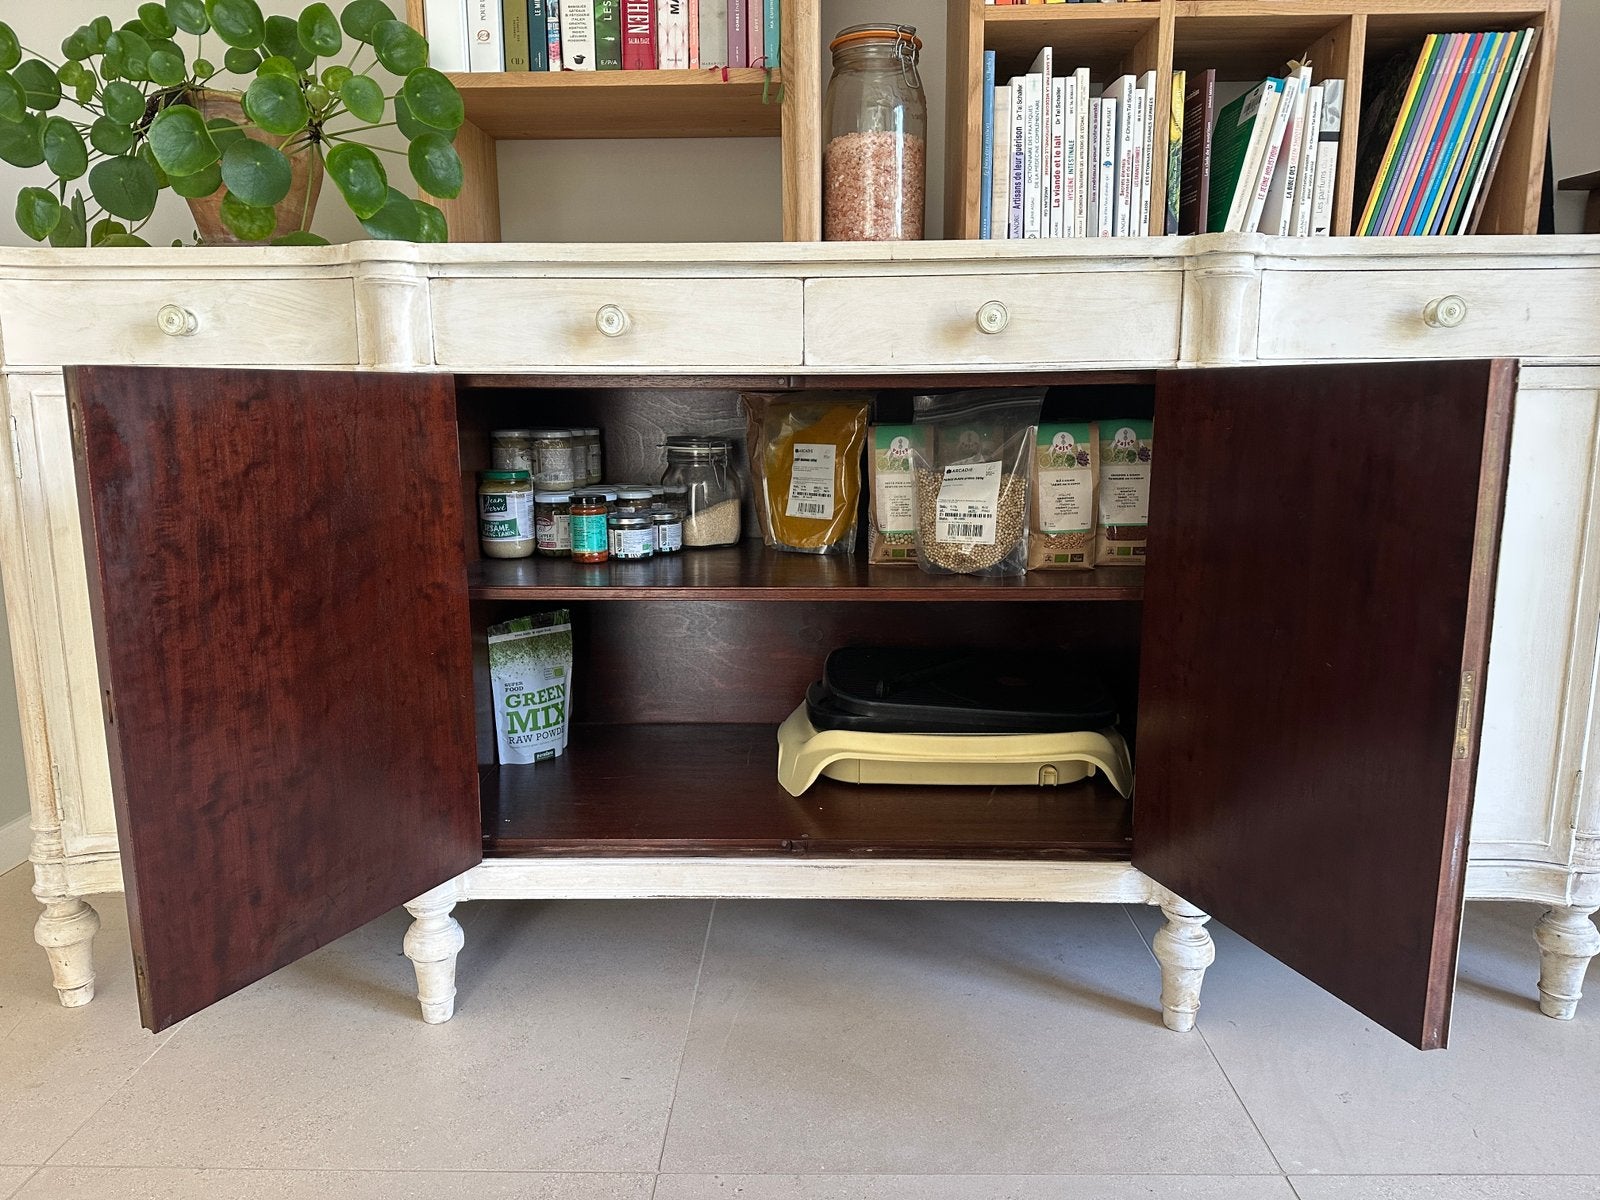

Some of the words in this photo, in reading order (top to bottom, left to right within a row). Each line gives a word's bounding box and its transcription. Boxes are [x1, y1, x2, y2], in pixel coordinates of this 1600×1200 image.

[603, 0, 612, 21] LES
[627, 0, 650, 34] HEN
[1013, 126, 1023, 156] guérison
[1053, 135, 1061, 149] lait
[1053, 150, 1061, 158] le
[1263, 145, 1278, 176] HOLISTIQUE
[1289, 148, 1299, 165] GREEN
[1013, 157, 1022, 171] leur
[1053, 159, 1061, 168] et
[1288, 165, 1296, 176] DES
[1013, 171, 1022, 181] de
[1053, 169, 1061, 197] viande
[1286, 176, 1294, 190] BIBLE
[1258, 176, 1269, 193] JEÛNE
[1317, 171, 1327, 201] parfums
[1012, 181, 1022, 210] Artisans
[1257, 193, 1264, 201] LE
[1285, 190, 1292, 199] LA
[1053, 197, 1060, 208] La
[486, 495, 505, 504] Jean
[505, 683, 565, 708] GREEN
[506, 700, 565, 735] MIX
[508, 733, 533, 744] RAW
